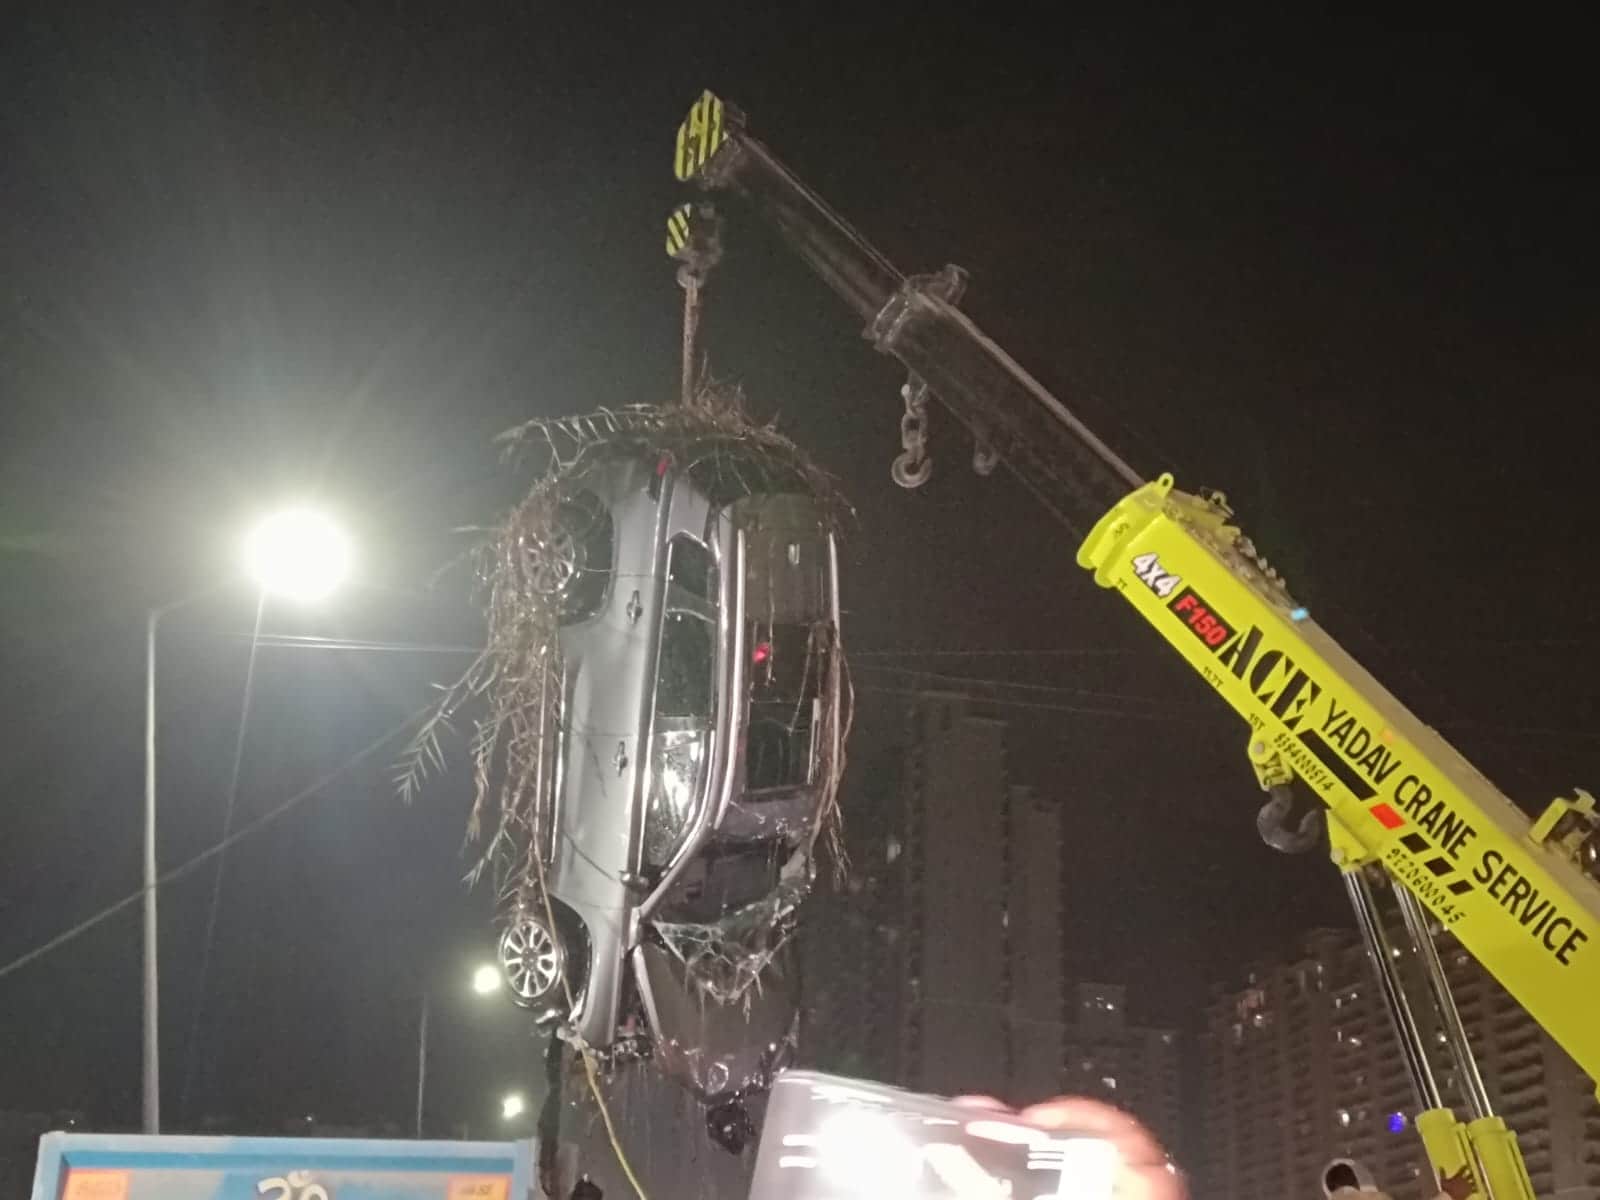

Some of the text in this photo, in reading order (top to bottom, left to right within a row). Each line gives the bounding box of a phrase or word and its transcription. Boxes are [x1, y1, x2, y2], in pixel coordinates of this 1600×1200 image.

[1175, 594, 1228, 646] F150
[1218, 624, 1322, 731] ACE
[1321, 698, 1588, 966] YADAV CRANE SERVICE
